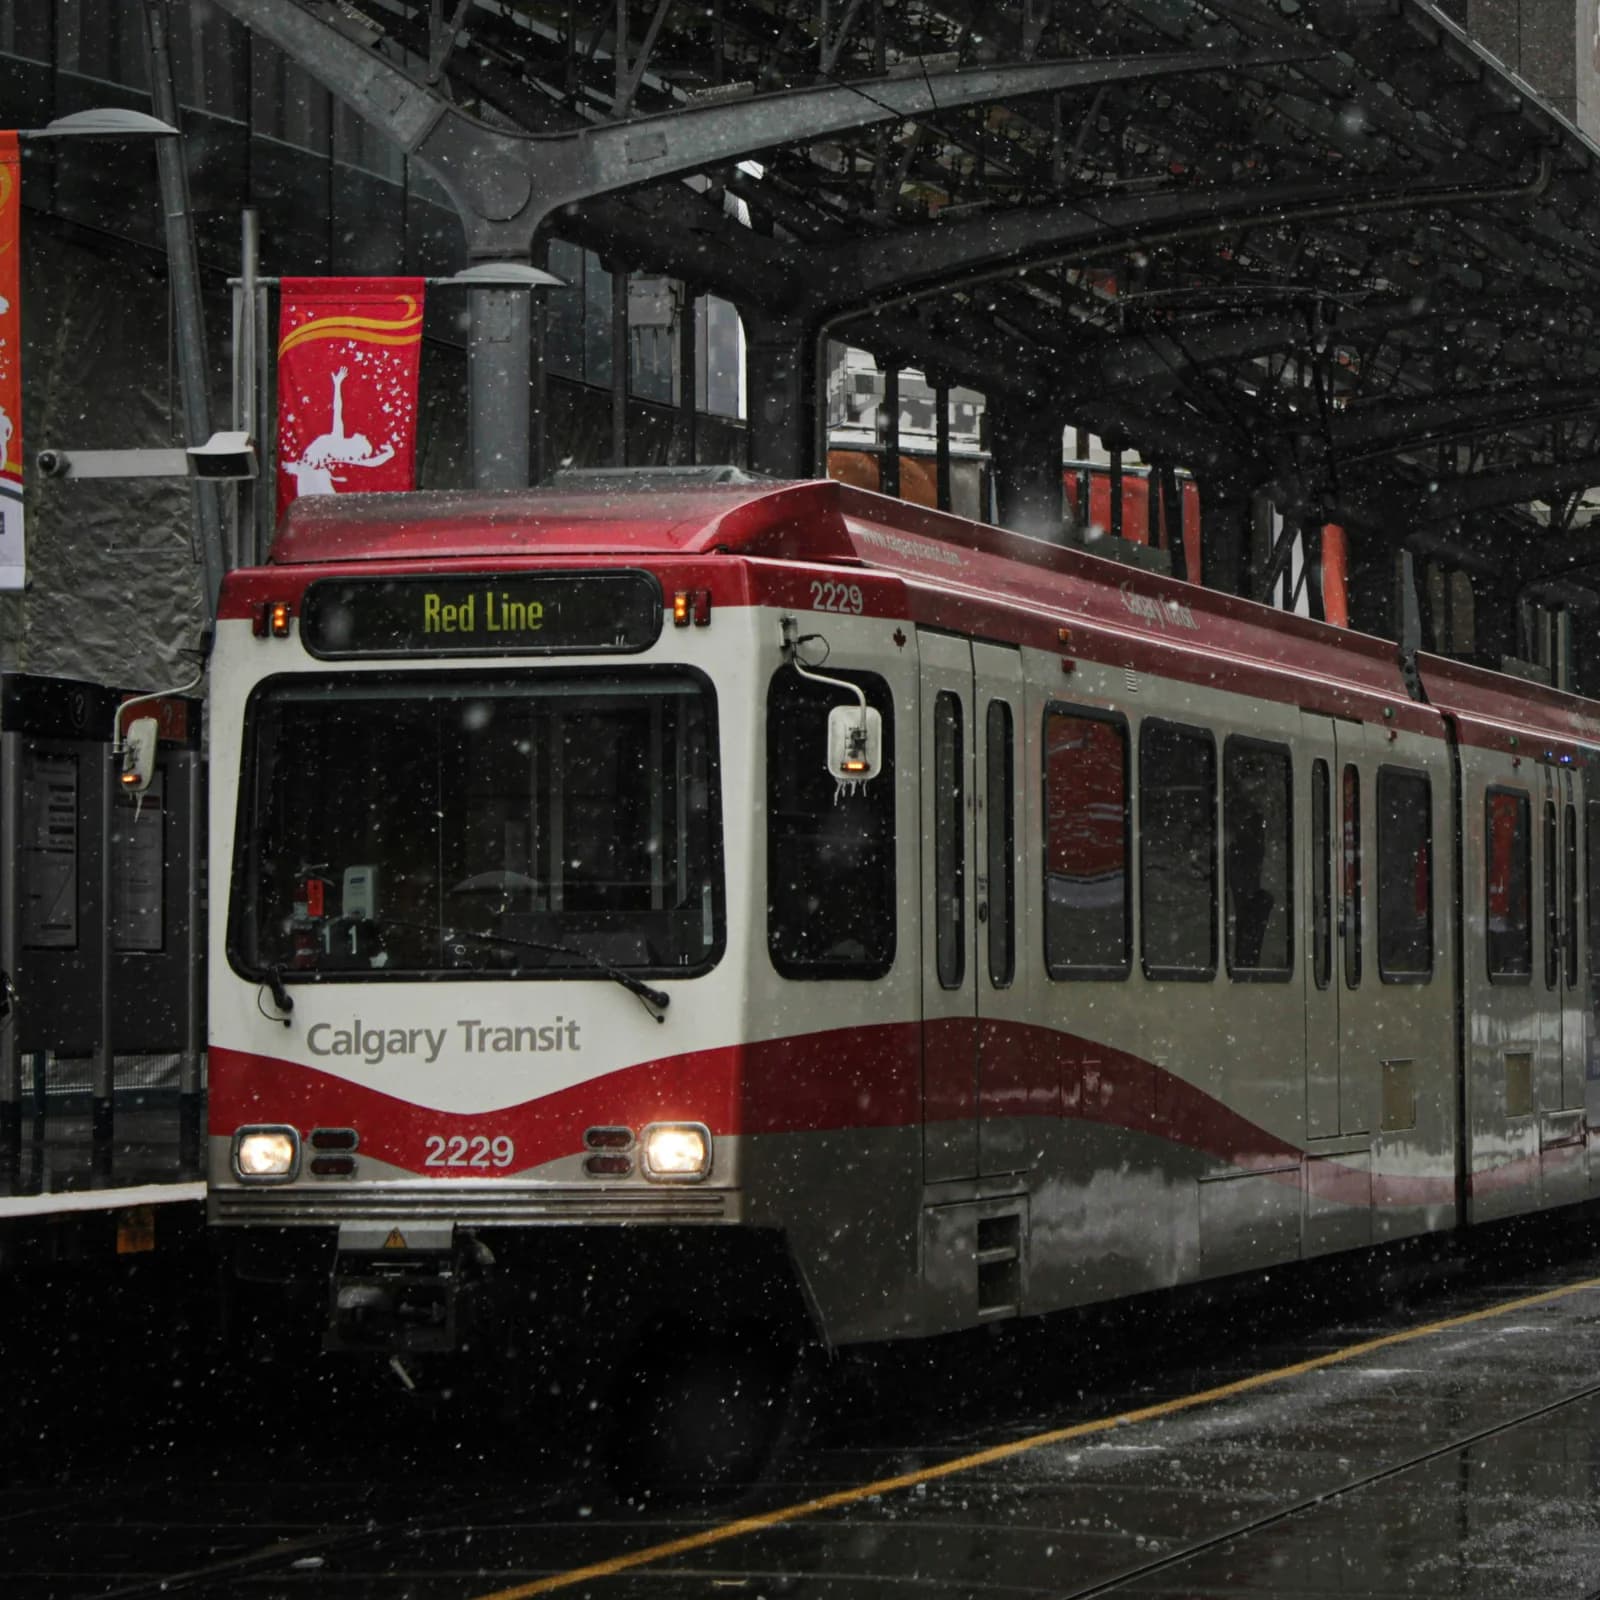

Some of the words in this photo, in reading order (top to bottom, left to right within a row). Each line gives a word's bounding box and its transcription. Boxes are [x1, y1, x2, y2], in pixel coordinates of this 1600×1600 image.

[424, 592, 475, 633] Red
[486, 591, 544, 632] Line
[810, 579, 864, 615] 2229
[306, 1019, 447, 1064] Calgary
[457, 1016, 581, 1052] Transit
[424, 1135, 515, 1168] 2229
